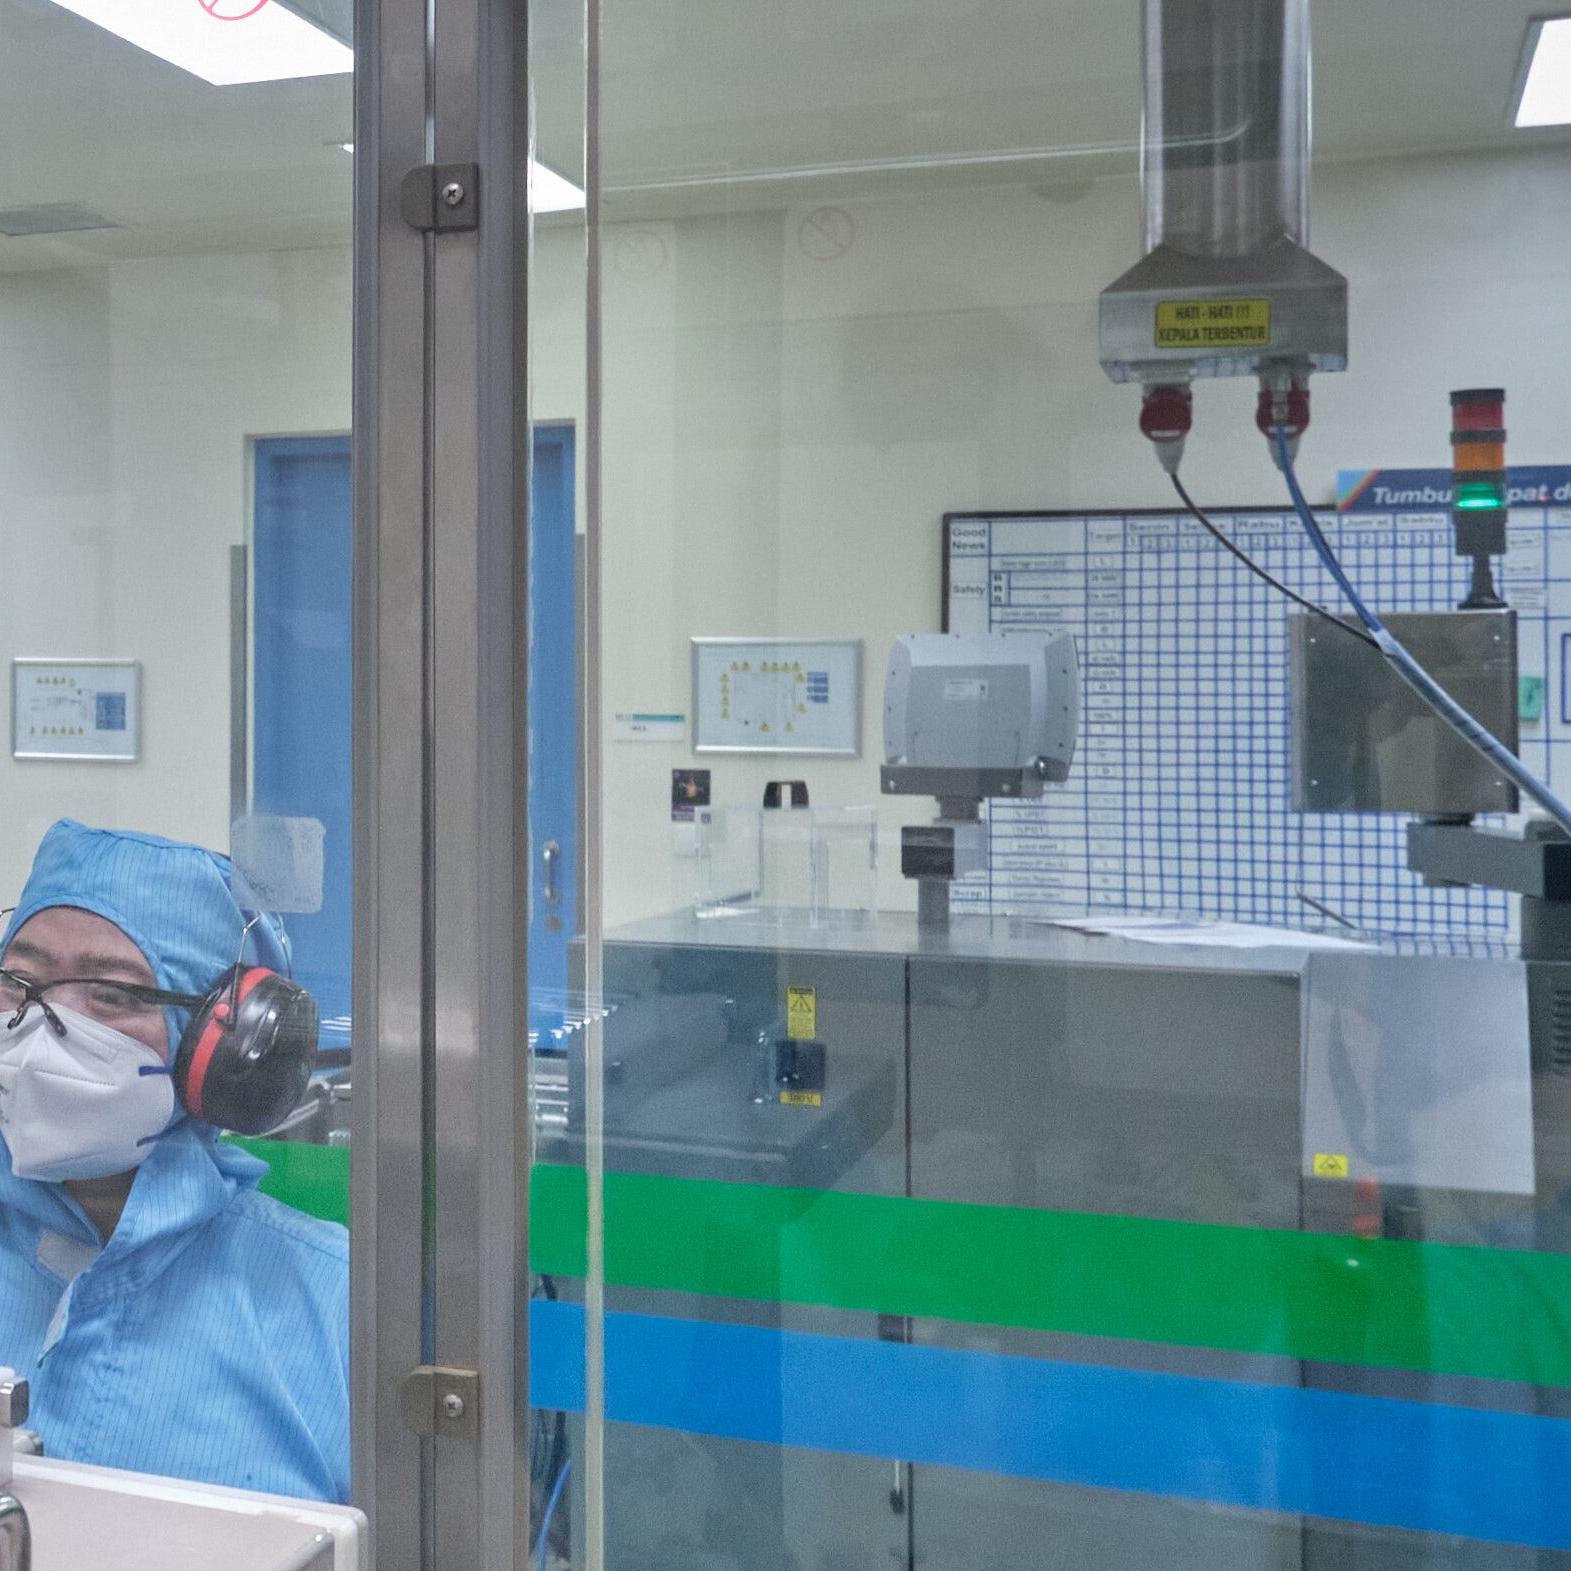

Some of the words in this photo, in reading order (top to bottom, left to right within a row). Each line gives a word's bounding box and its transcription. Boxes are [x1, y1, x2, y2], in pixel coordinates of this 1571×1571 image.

[1372, 486, 1453, 504] Tumbu
[952, 527, 986, 537] Good
[952, 541, 986, 550] News
